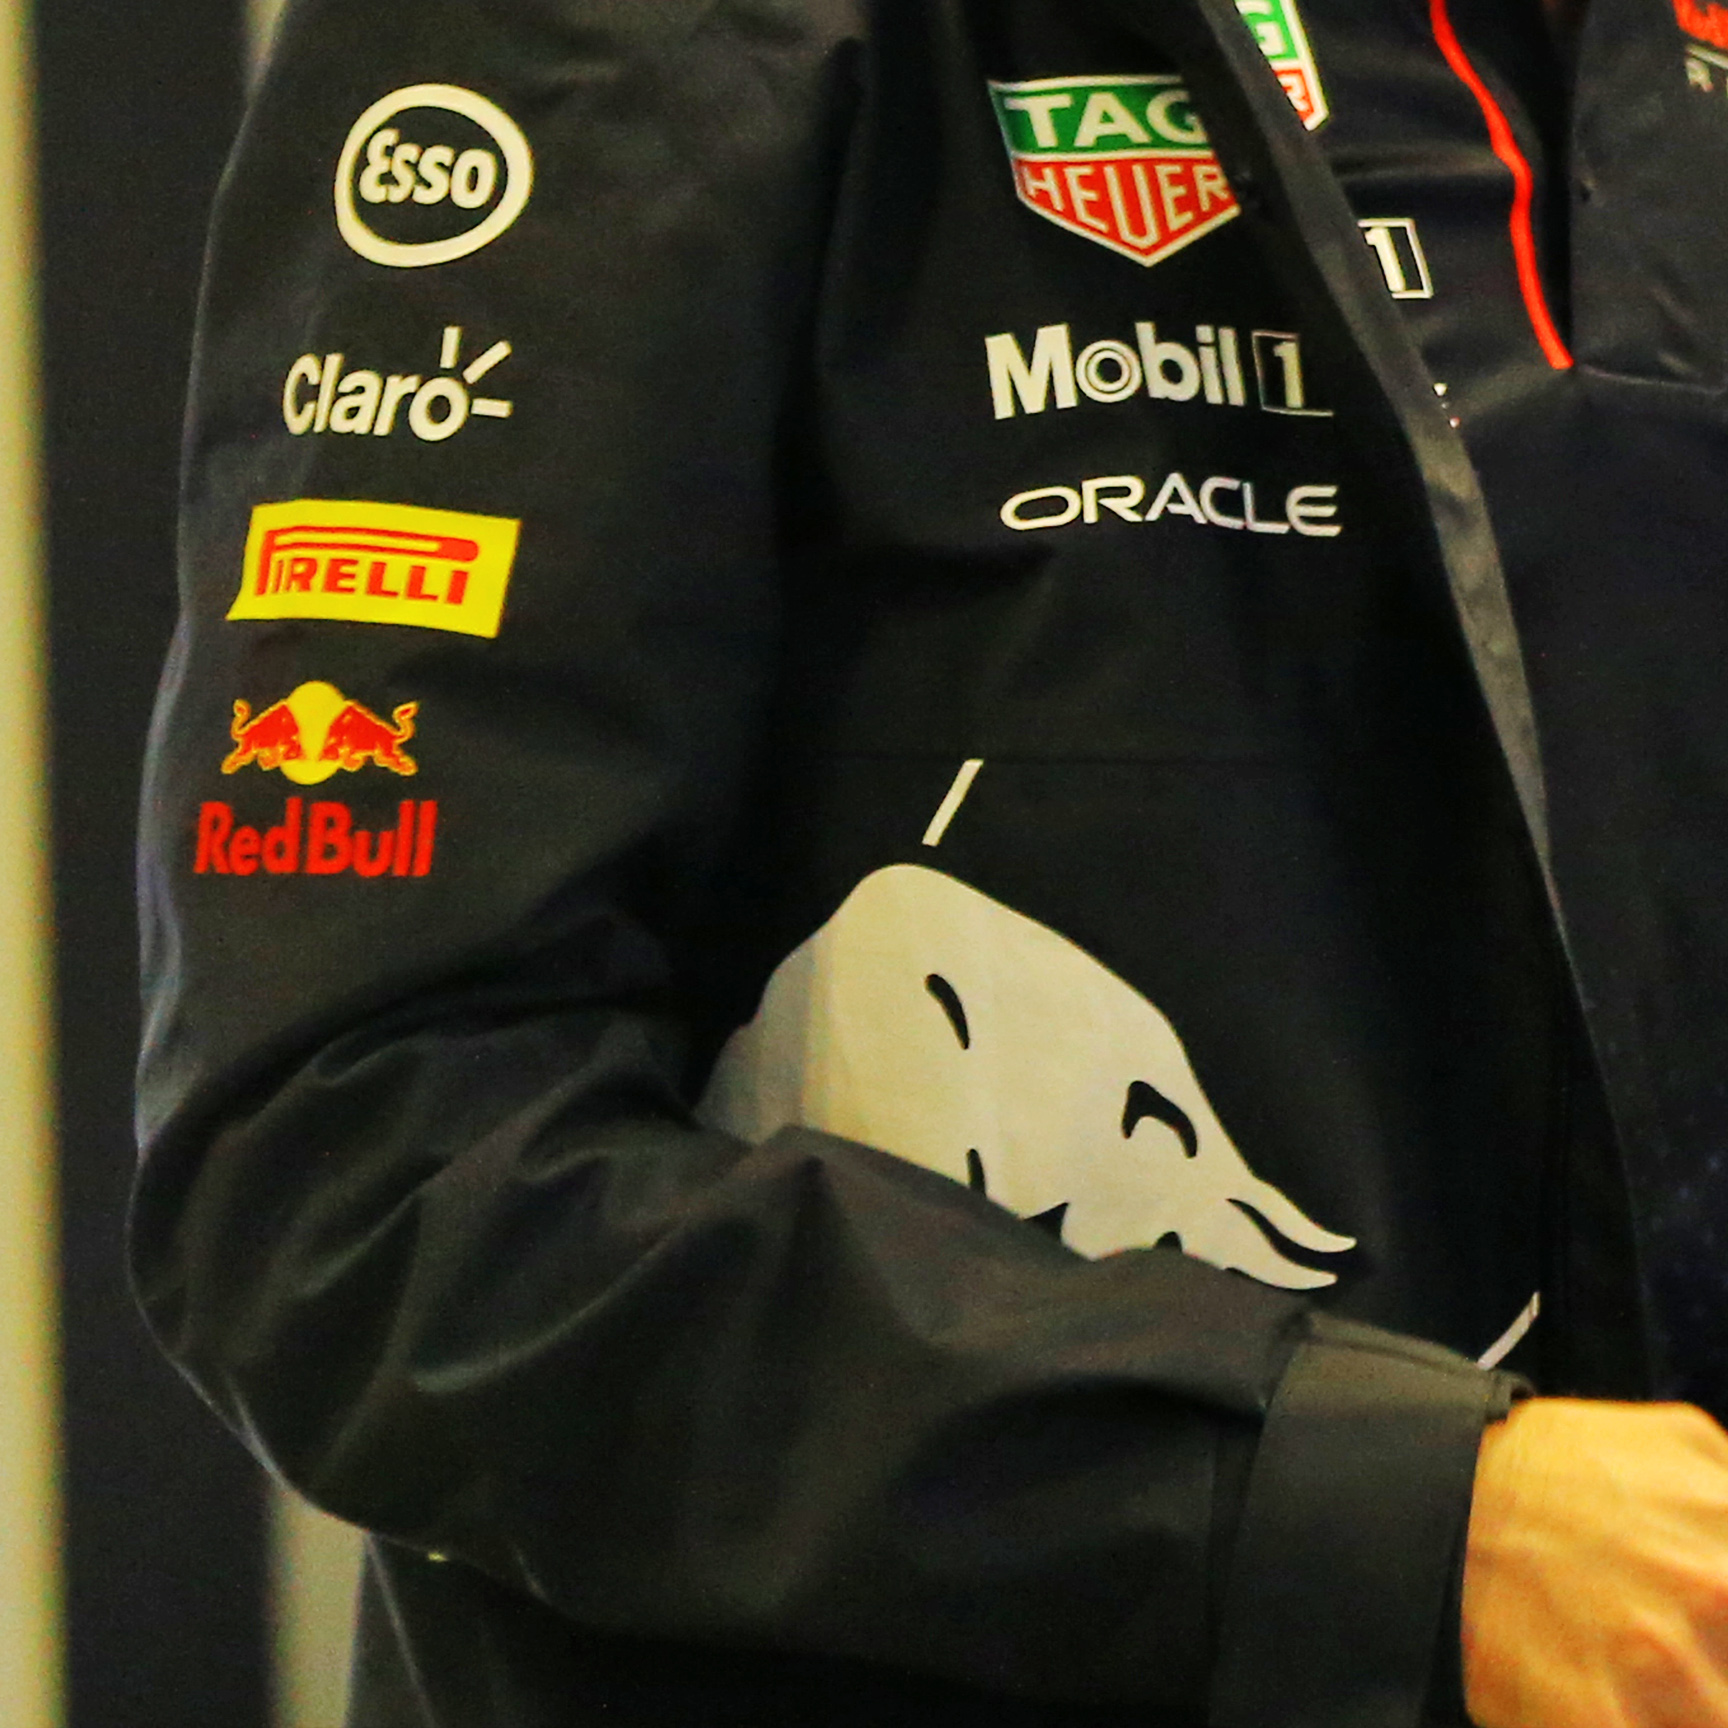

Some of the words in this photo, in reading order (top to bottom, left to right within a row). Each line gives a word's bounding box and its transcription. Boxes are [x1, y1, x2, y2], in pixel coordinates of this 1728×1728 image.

[1004, 89, 1210, 149] TAG
[358, 127, 497, 210] Esso
[1022, 163, 1233, 249] HEUER
[283, 352, 470, 442] Claro
[985, 322, 1247, 420] Mobil
[1000, 472, 1343, 538] ORACLE
[254, 525, 480, 606] PIRELLI
